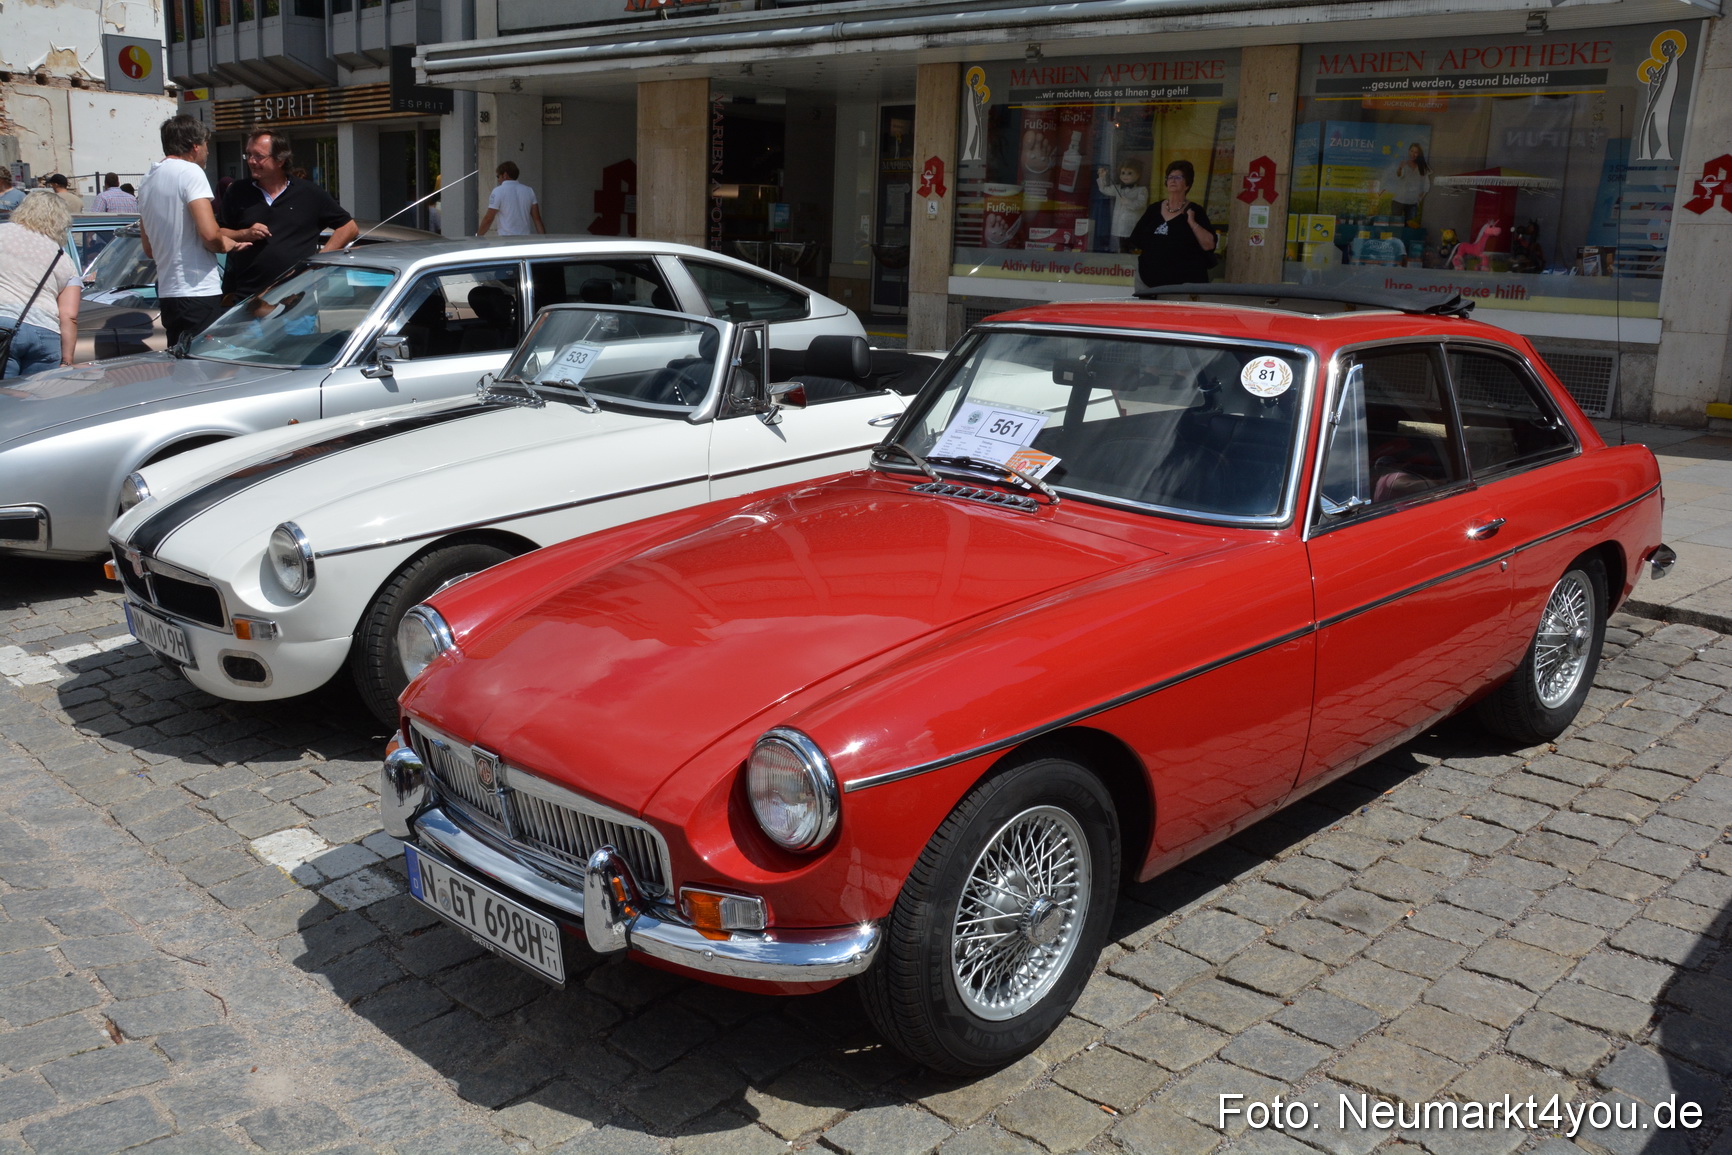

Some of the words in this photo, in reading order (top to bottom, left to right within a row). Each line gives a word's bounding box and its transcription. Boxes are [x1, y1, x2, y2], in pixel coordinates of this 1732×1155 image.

[1317, 50, 1425, 74] MARIEN
[1438, 41, 1612, 71] APOTHEKE
[1010, 65, 1091, 86] MARIEN
[1099, 60, 1226, 83] APOTHEKE
[1411, 76, 1455, 89] werden,
[1458, 75, 1499, 88] gesund
[1501, 73, 1549, 86] bleiben!
[1056, 89, 1092, 99] möchten,
[1093, 87, 1113, 97] dass
[1114, 89, 1124, 97] es
[1125, 86, 1149, 96] Ihnen
[1150, 87, 1165, 98] gut
[1166, 85, 1189, 97] geht!
[254, 94, 315, 121] ESPRIT
[399, 99, 444, 110] ESPRIT
[480, 111, 490, 123] 38
[1024, 119, 1057, 132] Fußpilz
[711, 94, 725, 175] MARIEN
[1330, 138, 1375, 148] ZADITEN
[711, 178, 724, 252] APOTH
[986, 202, 1020, 215] Fußpilz
[1001, 259, 1028, 272] Aktiv
[1030, 260, 1045, 273] für
[1048, 261, 1071, 274] Ihre
[566, 351, 589, 364] 533
[1259, 369, 1275, 381] 81
[989, 418, 1024, 437] 561
[150, 618, 168, 650] MO
[167, 628, 188, 659] 9H
[419, 859, 437, 904] N
[449, 877, 476, 927] GT
[484, 897, 545, 965] 698H
[541, 927, 555, 942] 04
[546, 956, 558, 972] 11
